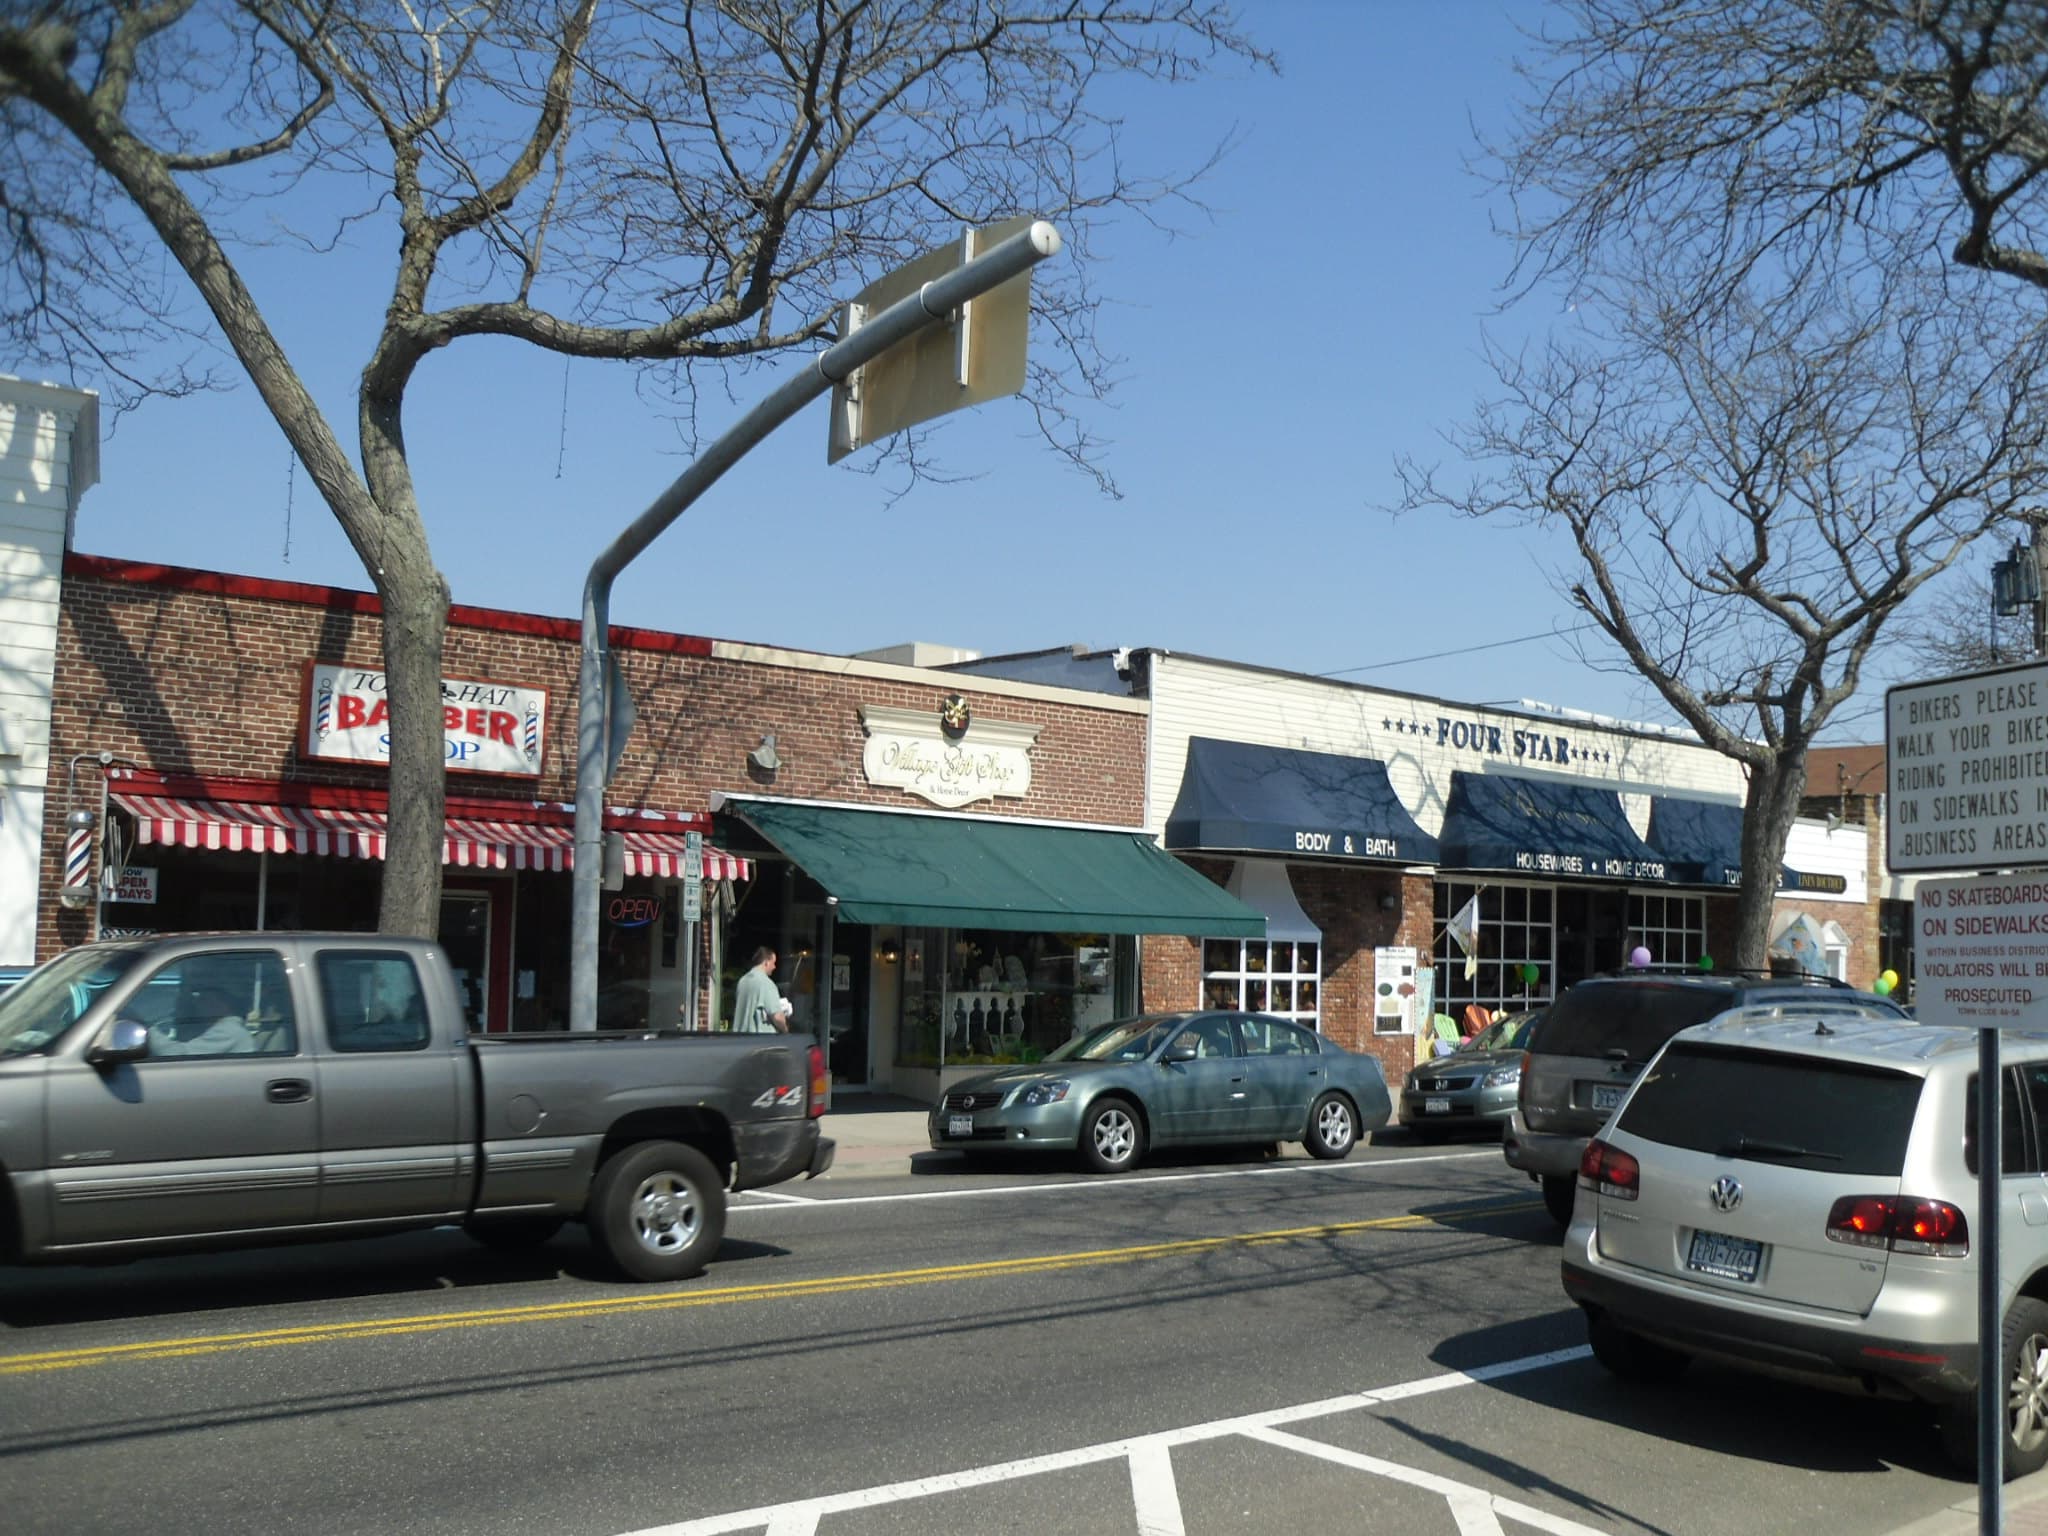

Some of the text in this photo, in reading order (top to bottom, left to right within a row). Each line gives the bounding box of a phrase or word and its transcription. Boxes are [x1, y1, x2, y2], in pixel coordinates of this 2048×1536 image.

[352, 672, 516, 706] TO HAT
[1909, 681, 2038, 725] BIKERS PLEASE
[337, 694, 519, 747] BABER
[378, 733, 481, 761] SOP
[1436, 716, 1570, 766] FOUR STAR
[1896, 731, 1935, 759] WALK
[1949, 724, 1990, 753] YOUR
[1897, 763, 1946, 792] RIDING
[1899, 799, 1918, 825] ON
[1933, 788, 2019, 822] SIDEWALKS
[1295, 831, 1396, 857] BODY & BATH
[1905, 821, 2047, 857] BUSINESS AREAS
[122, 868, 143, 876] OW
[1516, 851, 1665, 879] HOUSEWARES HOME DECOR
[118, 888, 153, 901] DAYS
[121, 876, 148, 889] PEN
[608, 898, 660, 921] OPEN
[1921, 889, 1942, 908] NO
[1922, 914, 2048, 937] ON SIDEWALKS
[1926, 947, 1957, 957] WITHIN
[1959, 945, 2006, 957] BUSINESS
[1924, 963, 1994, 977] VIOLATORS
[2000, 962, 2030, 977] WILL
[1945, 988, 2032, 1005] PROSECUTED
